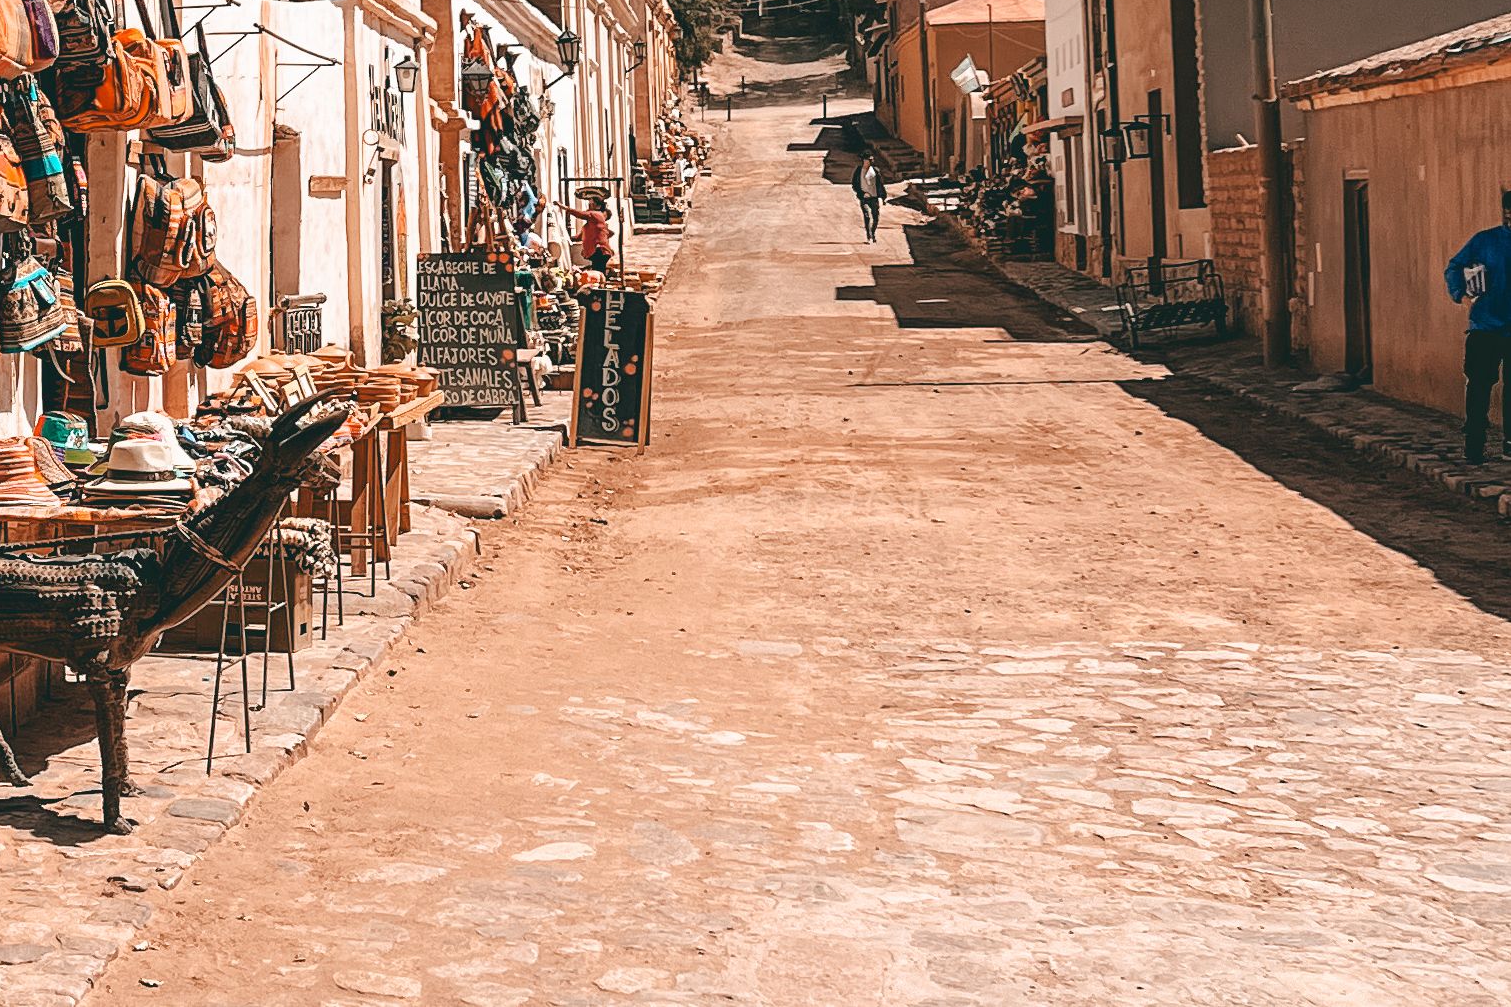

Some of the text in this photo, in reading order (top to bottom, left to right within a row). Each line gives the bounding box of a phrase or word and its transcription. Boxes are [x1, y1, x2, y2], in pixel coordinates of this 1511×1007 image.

[482, 262, 497, 275] DE
[419, 290, 515, 308] DULCE DE CAYOTE
[453, 310, 469, 326] DE
[420, 327, 458, 344] LICOR
[460, 328, 477, 344] DE
[421, 346, 499, 366] ALFAJORES
[601, 291, 621, 432] HELADOS
[461, 388, 477, 405] DE
